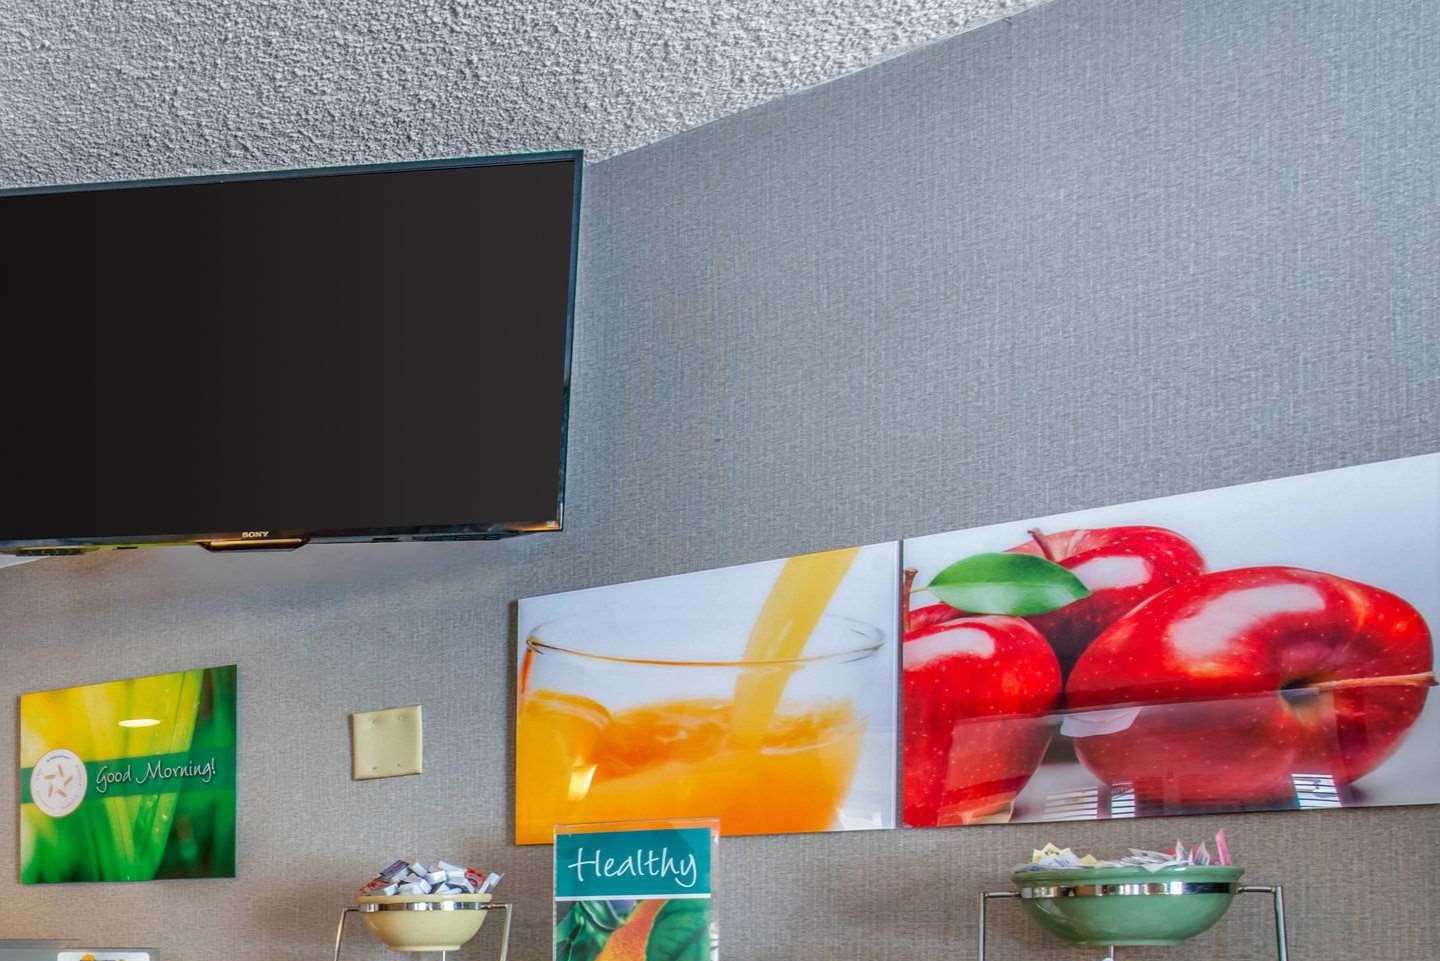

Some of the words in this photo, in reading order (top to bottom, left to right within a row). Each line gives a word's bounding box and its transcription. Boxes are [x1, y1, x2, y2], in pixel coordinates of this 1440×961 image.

[96, 764, 131, 794] Good
[136, 757, 216, 784] Morning!
[567, 847, 697, 888] Healthy
